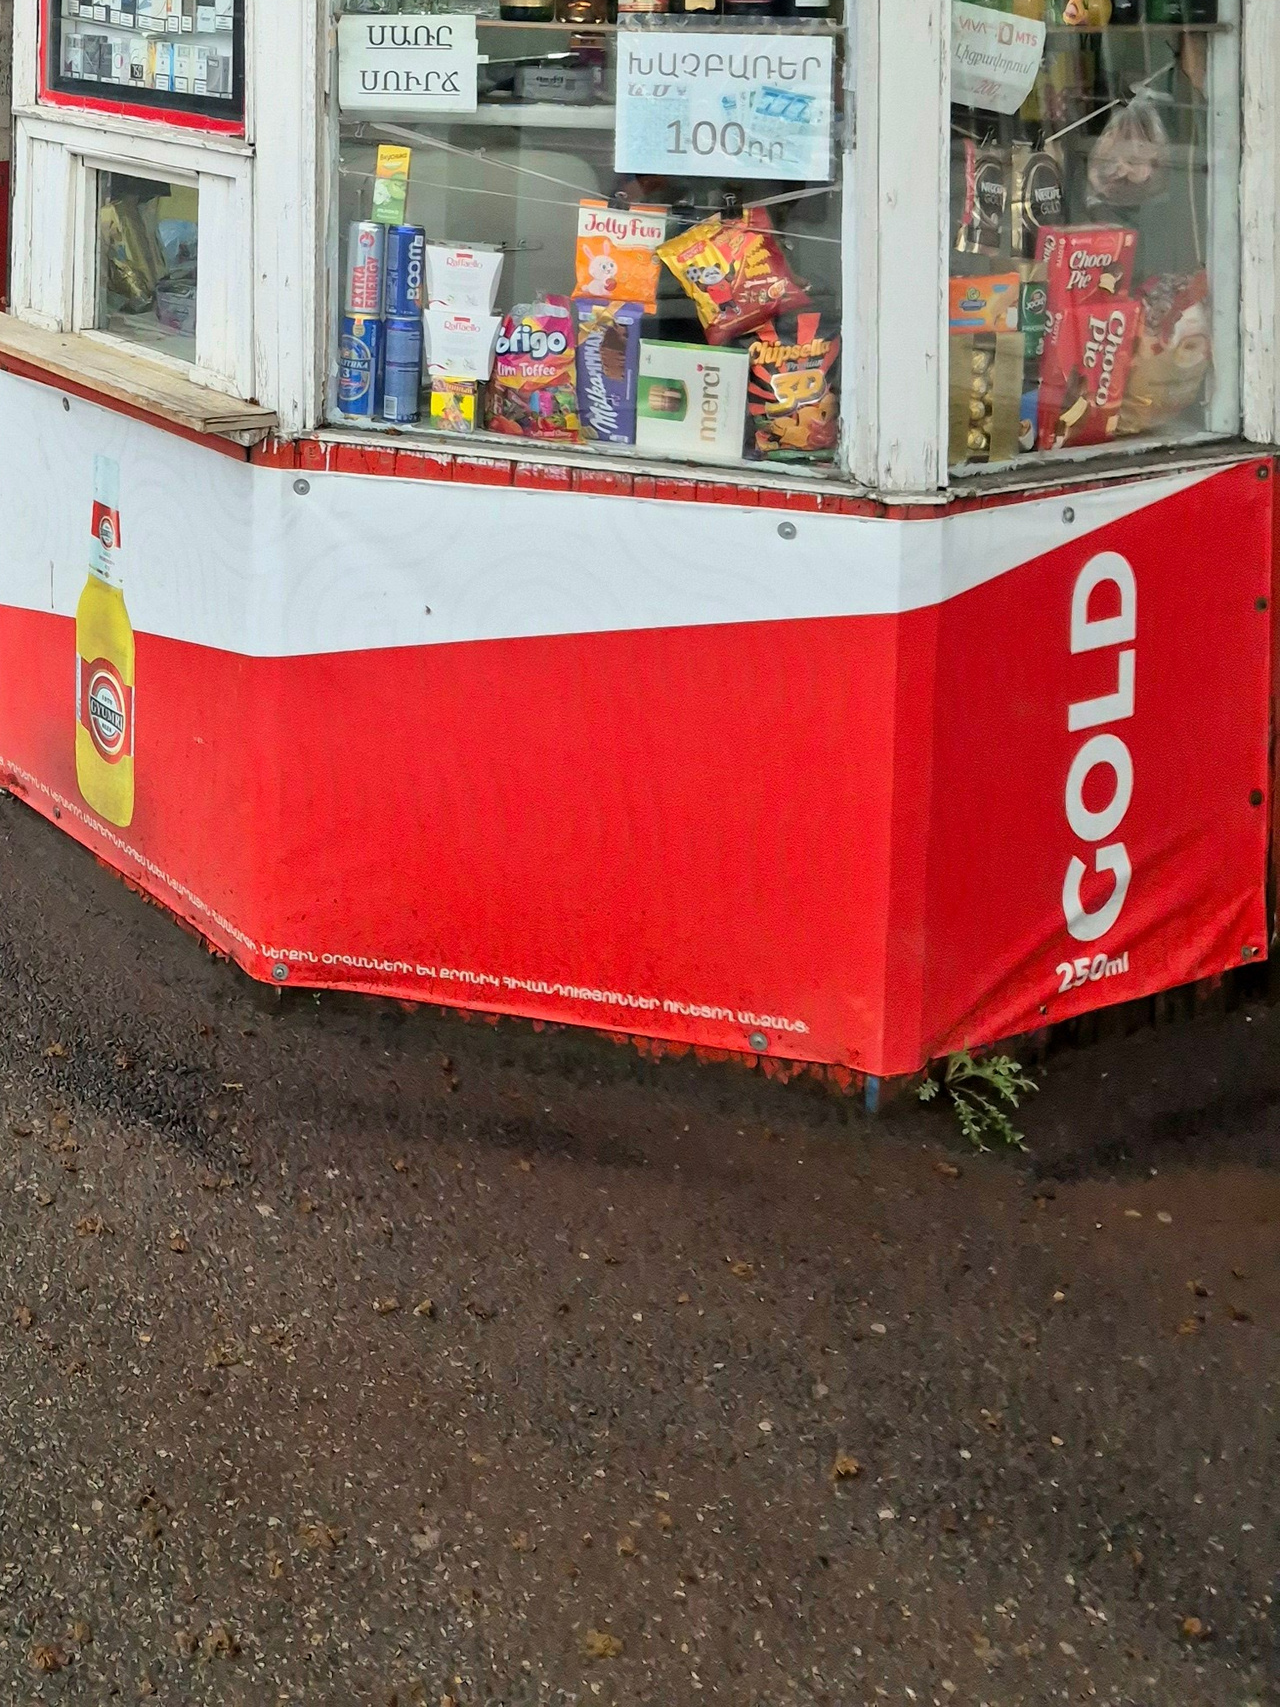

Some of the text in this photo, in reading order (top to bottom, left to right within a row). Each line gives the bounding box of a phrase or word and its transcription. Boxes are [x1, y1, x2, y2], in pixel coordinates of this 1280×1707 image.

[366, 25, 452, 48] ՍԱՌԸ
[1015, 32, 1038, 47] MTS
[628, 51, 821, 81] ԽԱՉԲԱՌԵՐ
[585, 213, 662, 239] Jolly Fun
[446, 256, 483, 269] Raffaello
[1070, 250, 1112, 270] Choco
[351, 265, 365, 308] EXTRA
[365, 256, 378, 308] ENERGY
[1066, 270, 1092, 290] Pie
[444, 320, 481, 333] Raffaello
[496, 326, 567, 358] ofigo
[1083, 315, 1108, 369] Pie
[343, 368, 350, 378] 3
[519, 363, 556, 377] Toffee
[1096, 310, 1125, 406] Choco
[699, 365, 720, 443] merci
[91, 698, 123, 732] GYUMRI
[1063, 551, 1137, 942] GOLD
[260, 944, 318, 963] ՆԵՐՔԻՆ
[321, 953, 413, 974] ՕՐԳԱՆՆԵՐԻ
[439, 968, 499, 987] ՔՐՈՆԻԿ
[1054, 951, 1130, 995] 250ml
